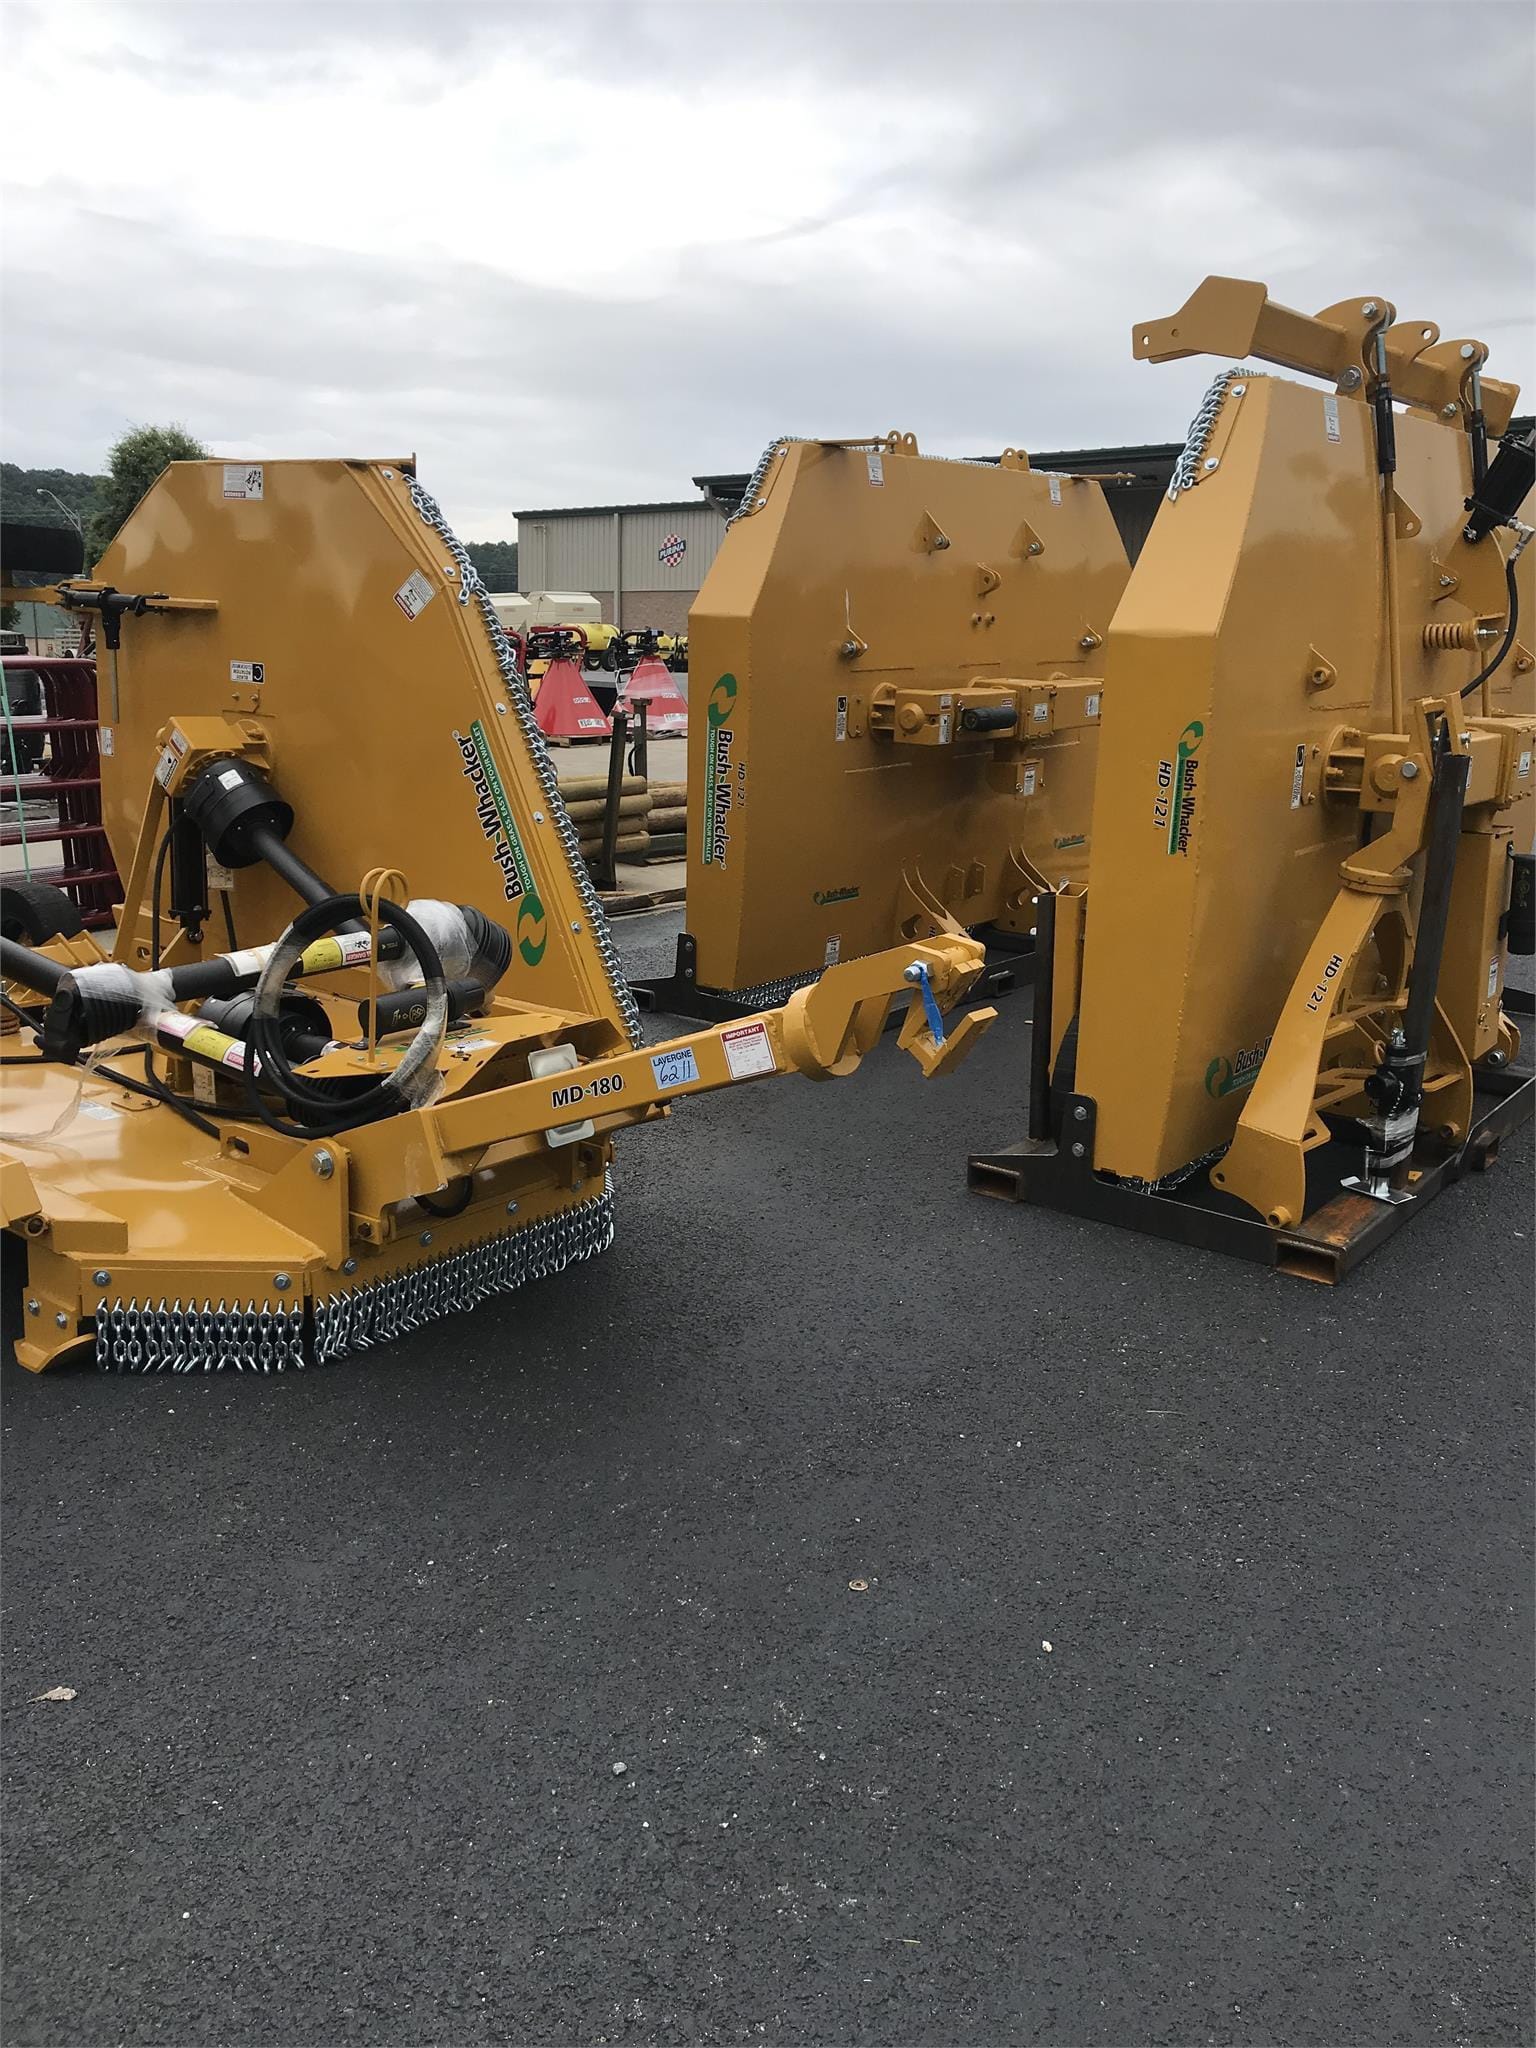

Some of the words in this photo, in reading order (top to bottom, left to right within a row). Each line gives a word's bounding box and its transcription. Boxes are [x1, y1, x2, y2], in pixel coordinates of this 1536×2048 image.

[660, 541, 685, 559] PURINA
[473, 726, 488, 758] WALLET
[484, 757, 496, 782] YOUR
[492, 780, 500, 795] ON
[713, 730, 733, 863] Bush-Whacker
[736, 763, 745, 807] HD-121
[1154, 760, 1171, 828] HD-121
[457, 734, 524, 901] Bush-Whacker
[497, 795, 508, 816] EASY
[1178, 760, 1198, 854] Bush-Whacker
[504, 816, 519, 846] GRASS,
[515, 847, 522, 860] ON
[518, 861, 532, 891] TOUGH
[1306, 954, 1343, 1012] HD-121
[725, 1026, 760, 1040] IMPORTANT
[653, 1050, 692, 1067] LAVERGNE
[659, 1060, 691, 1084] 6211
[552, 1073, 624, 1109] MD-180
